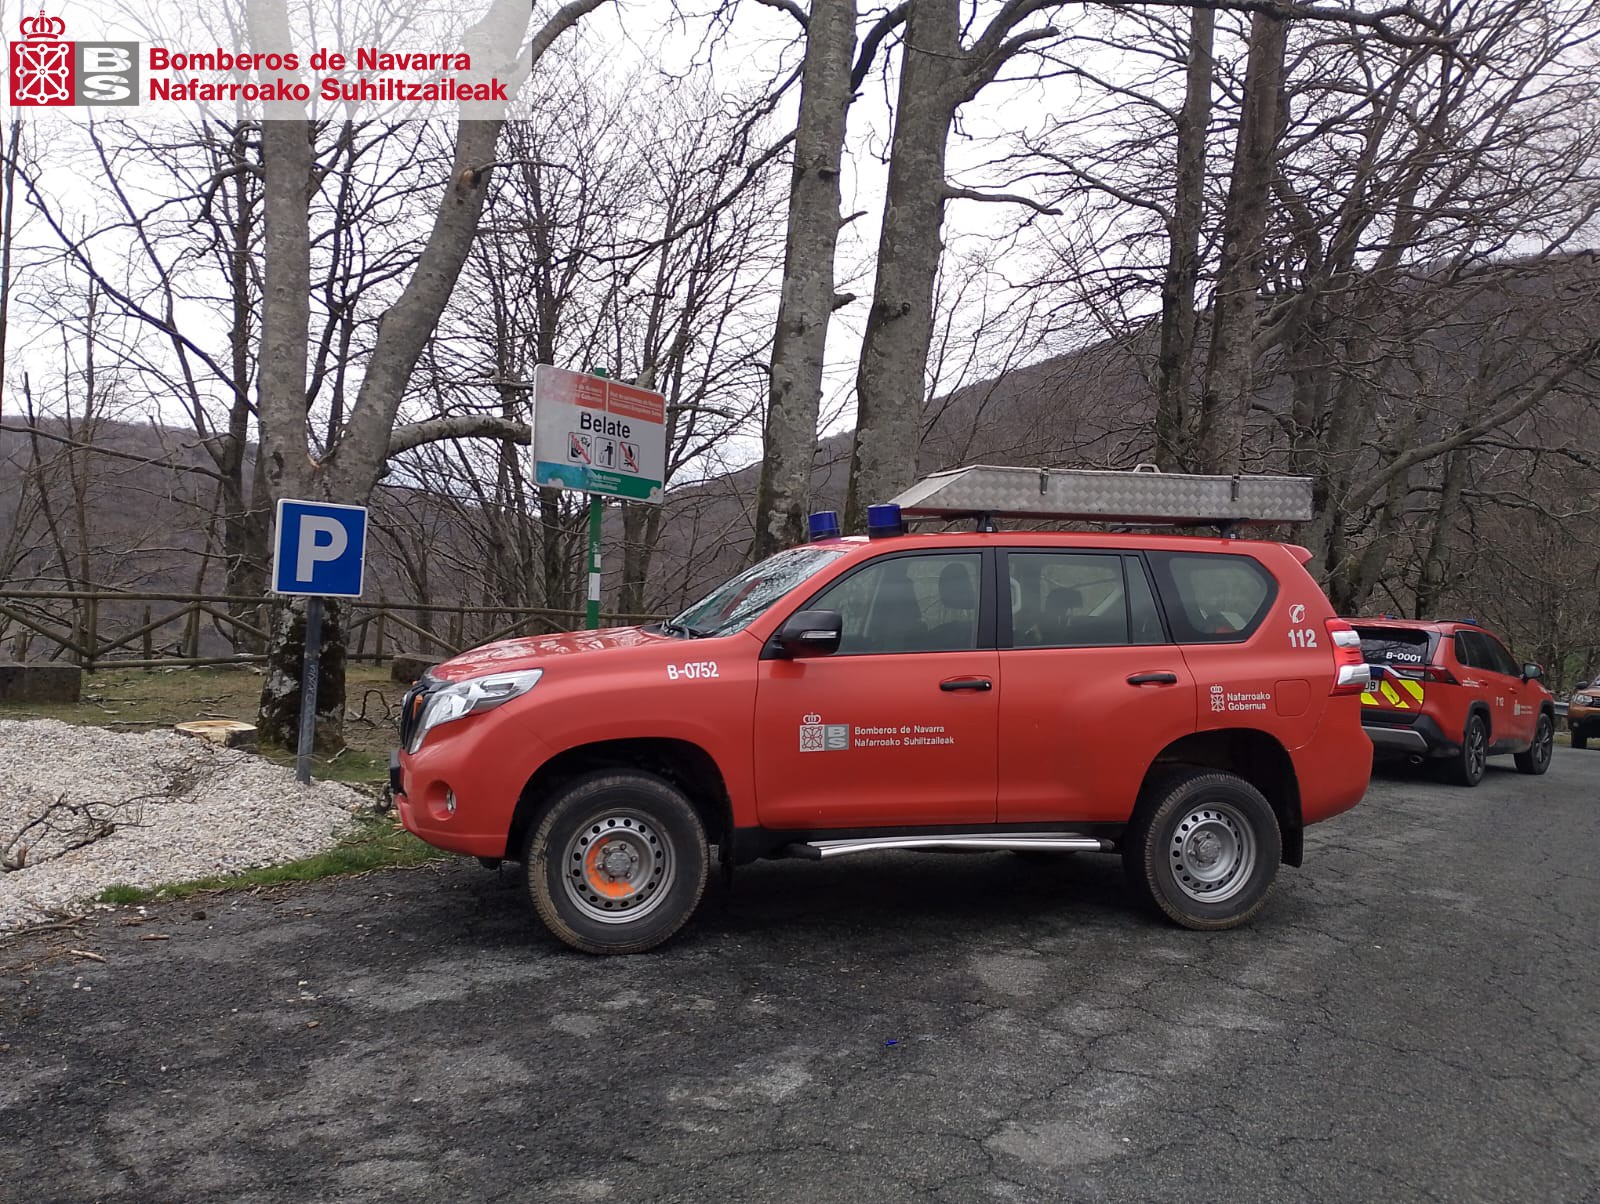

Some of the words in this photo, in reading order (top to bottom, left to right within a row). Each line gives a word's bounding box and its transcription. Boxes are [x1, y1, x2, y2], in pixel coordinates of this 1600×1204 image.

[580, 411, 631, 439] Belate
[296, 514, 348, 583] P
[1288, 629, 1318, 648] 112
[1385, 651, 1422, 663] B-0001
[666, 661, 720, 680] B-0752
[1227, 692, 1271, 702] Nafarroako
[1228, 702, 1267, 711] Gobernua
[854, 726, 897, 735] Bomberos
[900, 725, 911, 734] de
[914, 725, 945, 734] Navarra
[854, 737, 901, 747] Nafarroako
[903, 736, 955, 746] Suhiltzaileak
